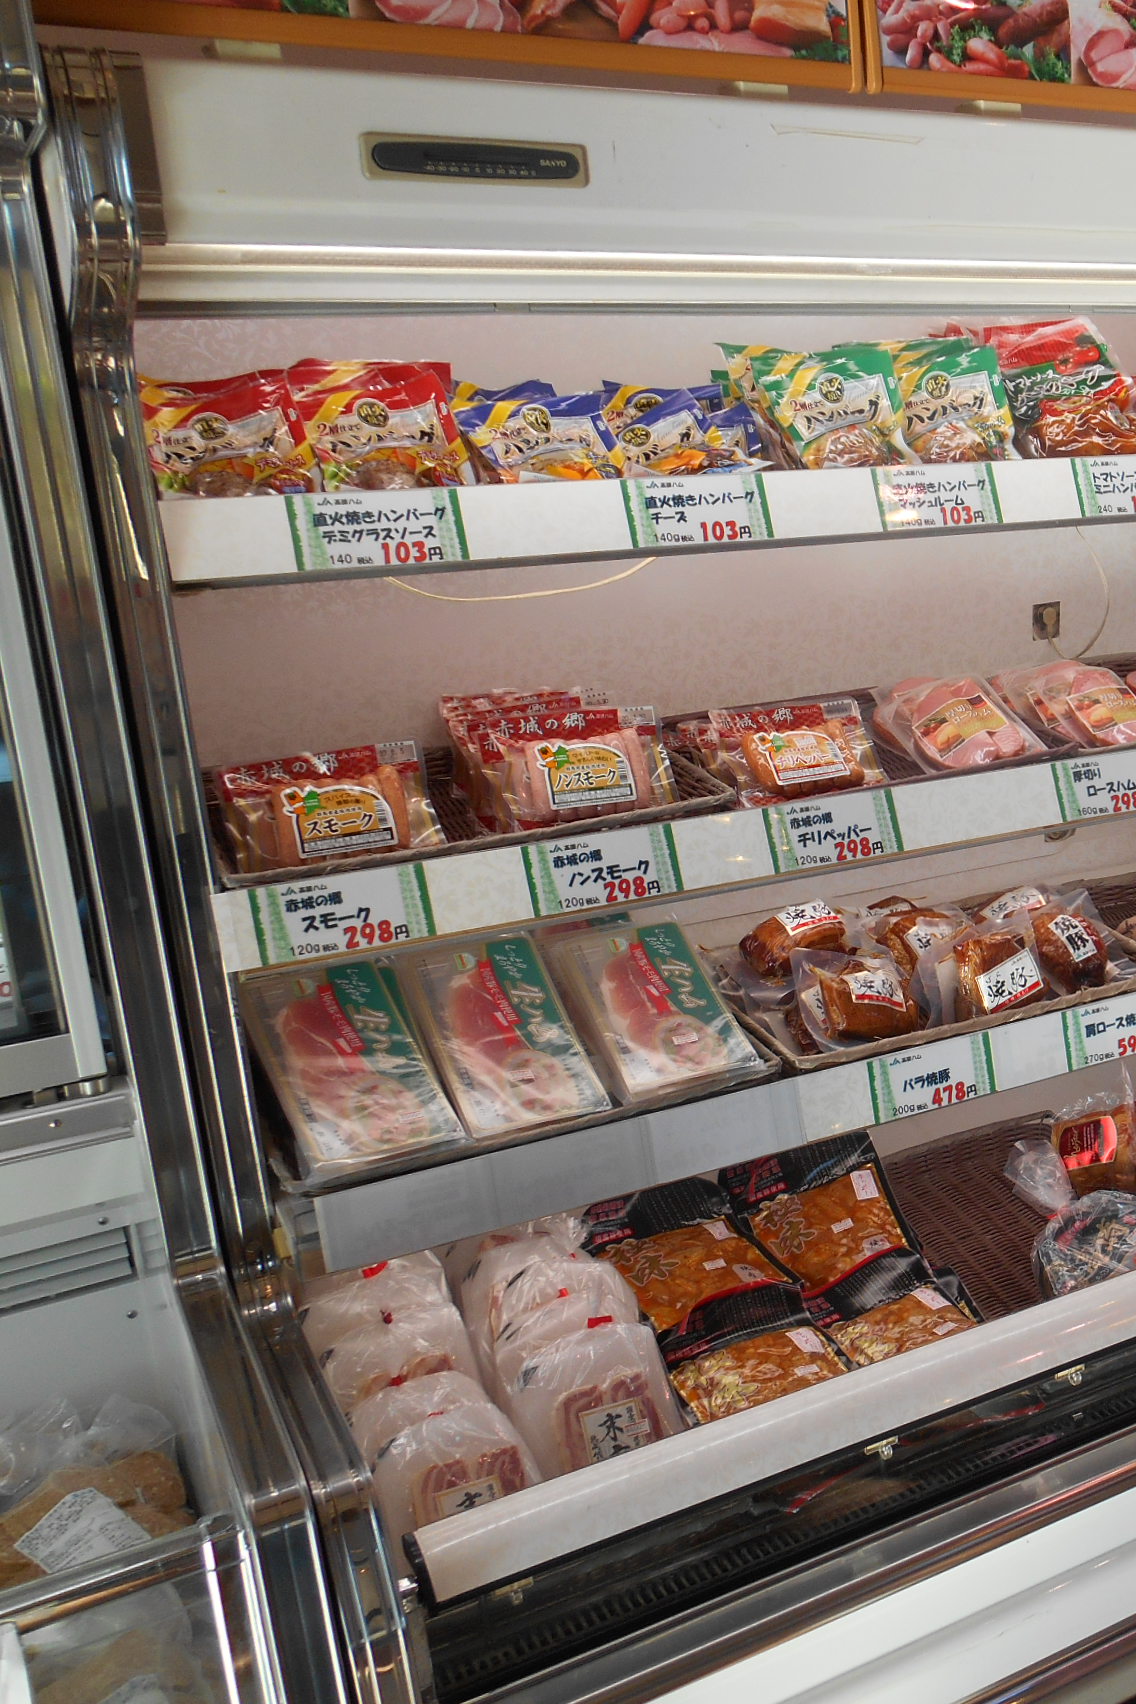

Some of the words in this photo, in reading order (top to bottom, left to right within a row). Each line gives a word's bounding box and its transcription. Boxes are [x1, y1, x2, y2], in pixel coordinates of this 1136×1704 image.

[540, 159, 567, 168] SANYO
[645, 492, 755, 509] 直火焼きハンバーグ
[900, 495, 965, 507] マッシュルーム
[313, 507, 447, 527] 直火焼きハンバーグ
[651, 511, 688, 524] チーズ
[940, 505, 985, 526] 103円
[322, 527, 437, 544] デミグラスソース
[654, 533, 681, 544] 140g
[700, 520, 751, 542] 103円
[329, 554, 352, 565] 140
[381, 541, 444, 565] 103円
[493, 711, 586, 738] 赤城の郷
[776, 751, 832, 768] チリペッパー
[553, 768, 617, 790] ノンスモーク
[1073, 767, 1102, 784] 厚切り
[1087, 778, 1136, 797] ロースハム
[304, 812, 374, 837] スモーク
[789, 811, 833, 830] 赤城の郷
[797, 826, 873, 848] チリペッパー
[553, 849, 603, 868] 赤城の郷
[794, 855, 818, 867] 120g
[834, 836, 885, 862] 298円
[568, 859, 650, 888] ノンスモーク
[285, 891, 344, 913] 赤城の郷
[557, 897, 585, 910] 120g
[604, 876, 661, 903] 298円
[302, 906, 371, 934] スモーク
[289, 943, 321, 958] 120g
[343, 920, 410, 949] 298円
[1084, 1053, 1104, 1065] 270g
[902, 1068, 951, 1092] バラ焼豚
[892, 1104, 915, 1117] 200g
[932, 1081, 978, 1107] 478円
